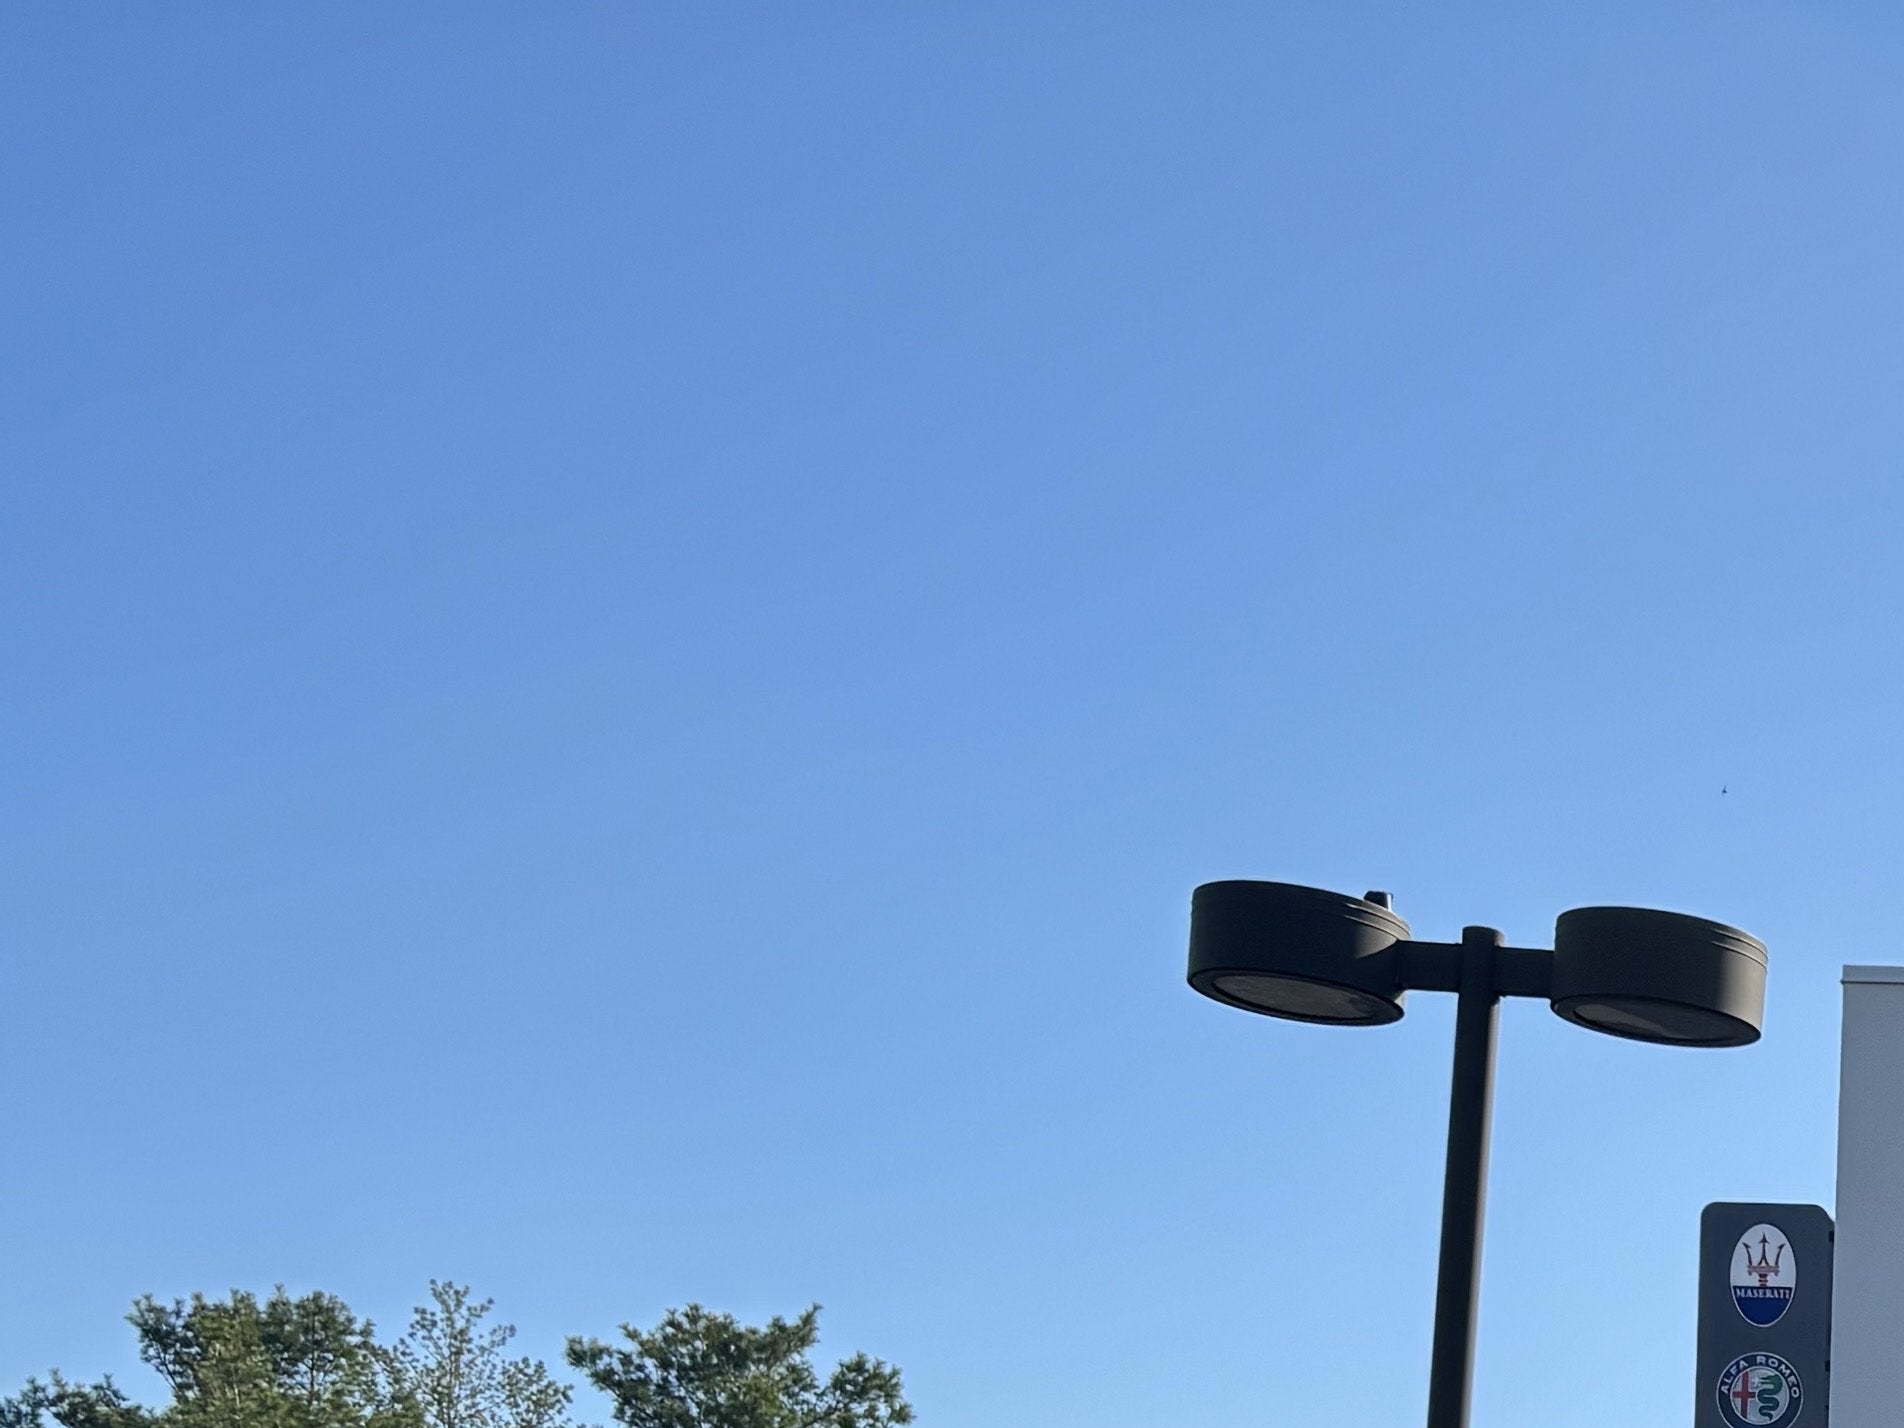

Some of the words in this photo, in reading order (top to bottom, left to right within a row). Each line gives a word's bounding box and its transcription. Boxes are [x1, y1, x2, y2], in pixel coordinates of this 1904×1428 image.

[1736, 1287, 1791, 1299] MASERATI
[1720, 1360, 1749, 1395] ALFA
[1756, 1355, 1800, 1398] ROMEO
